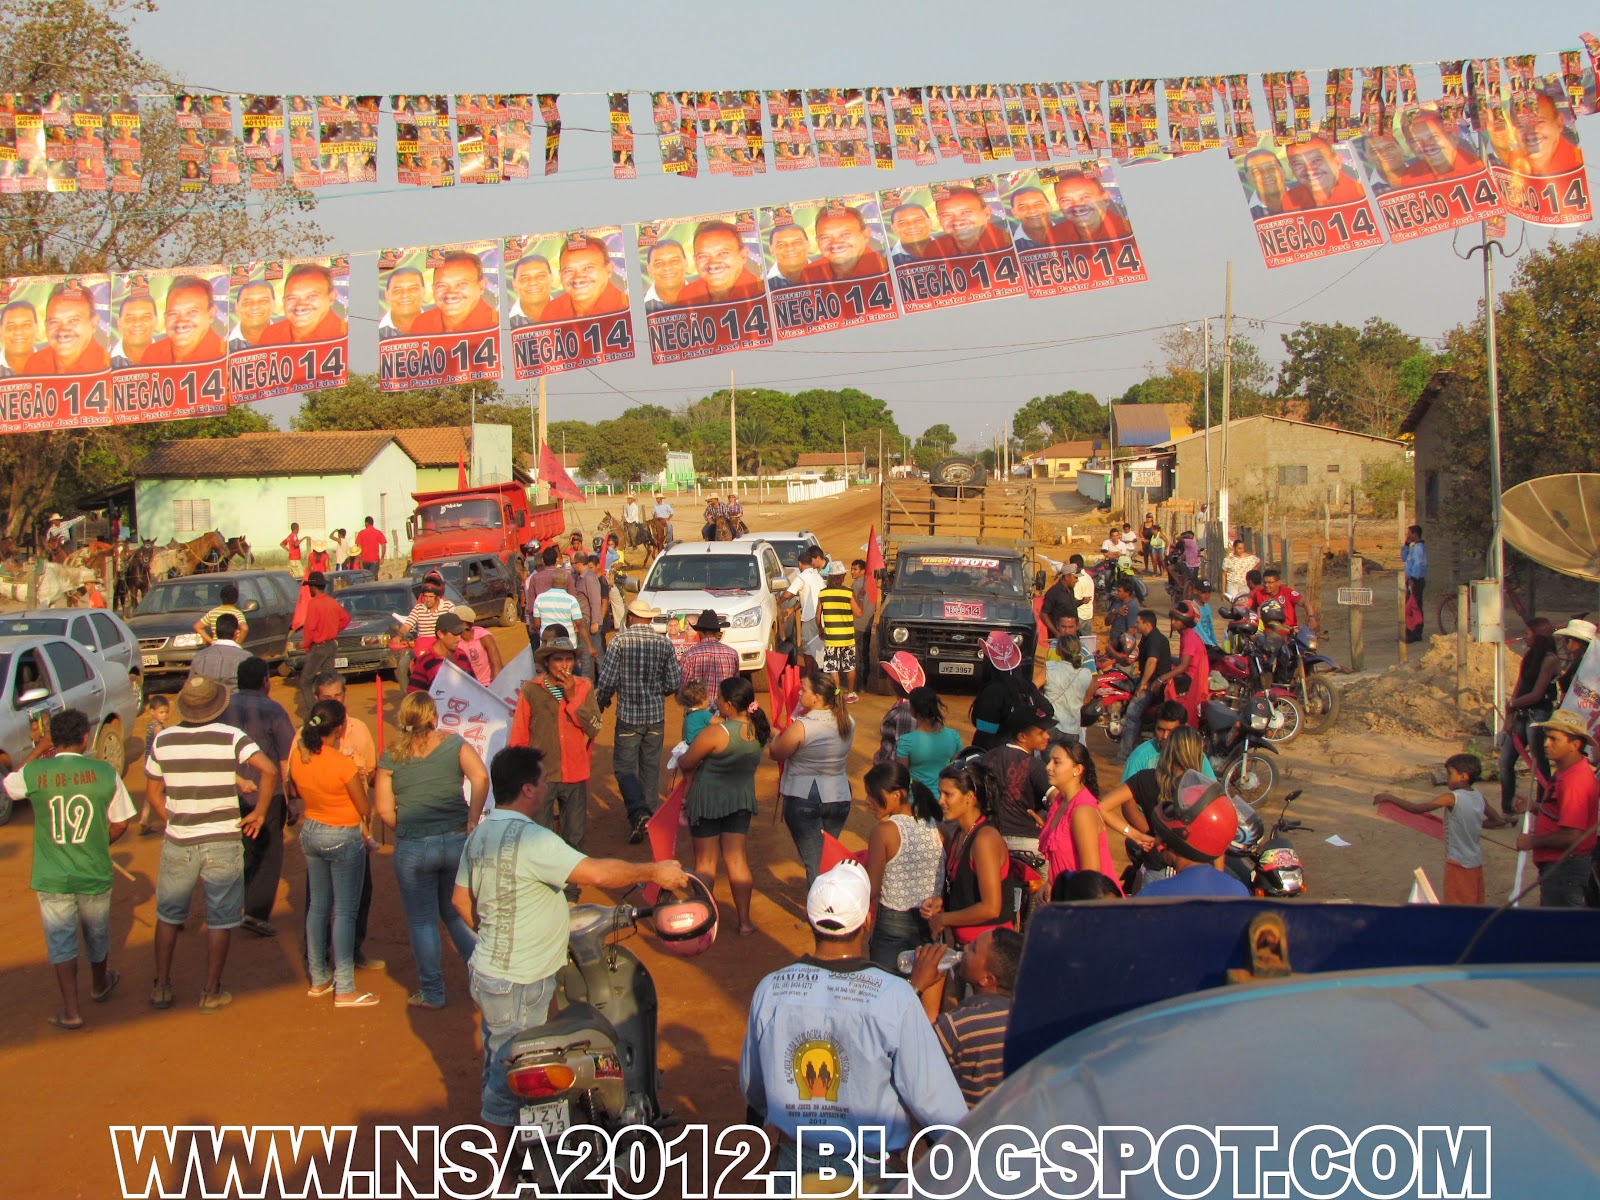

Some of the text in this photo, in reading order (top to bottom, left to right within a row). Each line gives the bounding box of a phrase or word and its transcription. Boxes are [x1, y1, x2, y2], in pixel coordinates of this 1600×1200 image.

[1380, 178, 1499, 232] NEGÃO 14
[1541, 178, 1588, 214] 14
[1258, 208, 1376, 258] NEGÃO 14
[1420, 222, 1450, 234] Pastor
[1452, 216, 1474, 226] José
[1476, 208, 1505, 219] Edson
[1295, 249, 1326, 260] Pastor
[1328, 244, 1351, 253] José
[1352, 238, 1381, 248] Edson
[1022, 244, 1142, 288] NEGÃO 14
[900, 256, 1020, 304] NEGÃO 14
[1058, 282, 1090, 292] Pastor
[1092, 278, 1114, 288] José
[1116, 274, 1146, 283] Edson
[774, 282, 894, 330] NEGÃO 14
[934, 296, 966, 307] Pastor
[968, 292, 991, 301] José
[994, 286, 1024, 296] Edson
[649, 304, 769, 353] NEGÃO 14
[807, 322, 839, 332] Pastor
[842, 317, 864, 326] José
[867, 312, 897, 321] Edson
[513, 319, 632, 370] NEGÃO 14
[682, 348, 714, 358] Pastor
[716, 344, 739, 352] José
[742, 338, 772, 348] Edson
[230, 346, 346, 393] NEGÃO 14
[380, 337, 498, 380] NEGÃO 14
[544, 362, 576, 372] Pastor
[578, 356, 601, 366] José
[604, 351, 634, 360] Edson
[112, 368, 226, 413] NEGÃO 14
[259, 386, 289, 398] Pastor
[291, 382, 314, 392] José
[316, 379, 346, 388] Edson
[411, 378, 442, 387] Pastor
[445, 374, 467, 383] José
[470, 371, 500, 380] Edson
[0, 380, 110, 422] NEGÃO 14
[141, 410, 171, 420] Pastor
[173, 407, 195, 416] José
[198, 404, 226, 412] Edson
[23, 421, 54, 429] Pastor
[56, 417, 78, 426] José
[81, 416, 110, 424] Edson
[967, 606, 981, 616] 14
[48, 794, 94, 844] 19
[848, 982, 880, 992] Fashion
[528, 1107, 563, 1124] JZV
